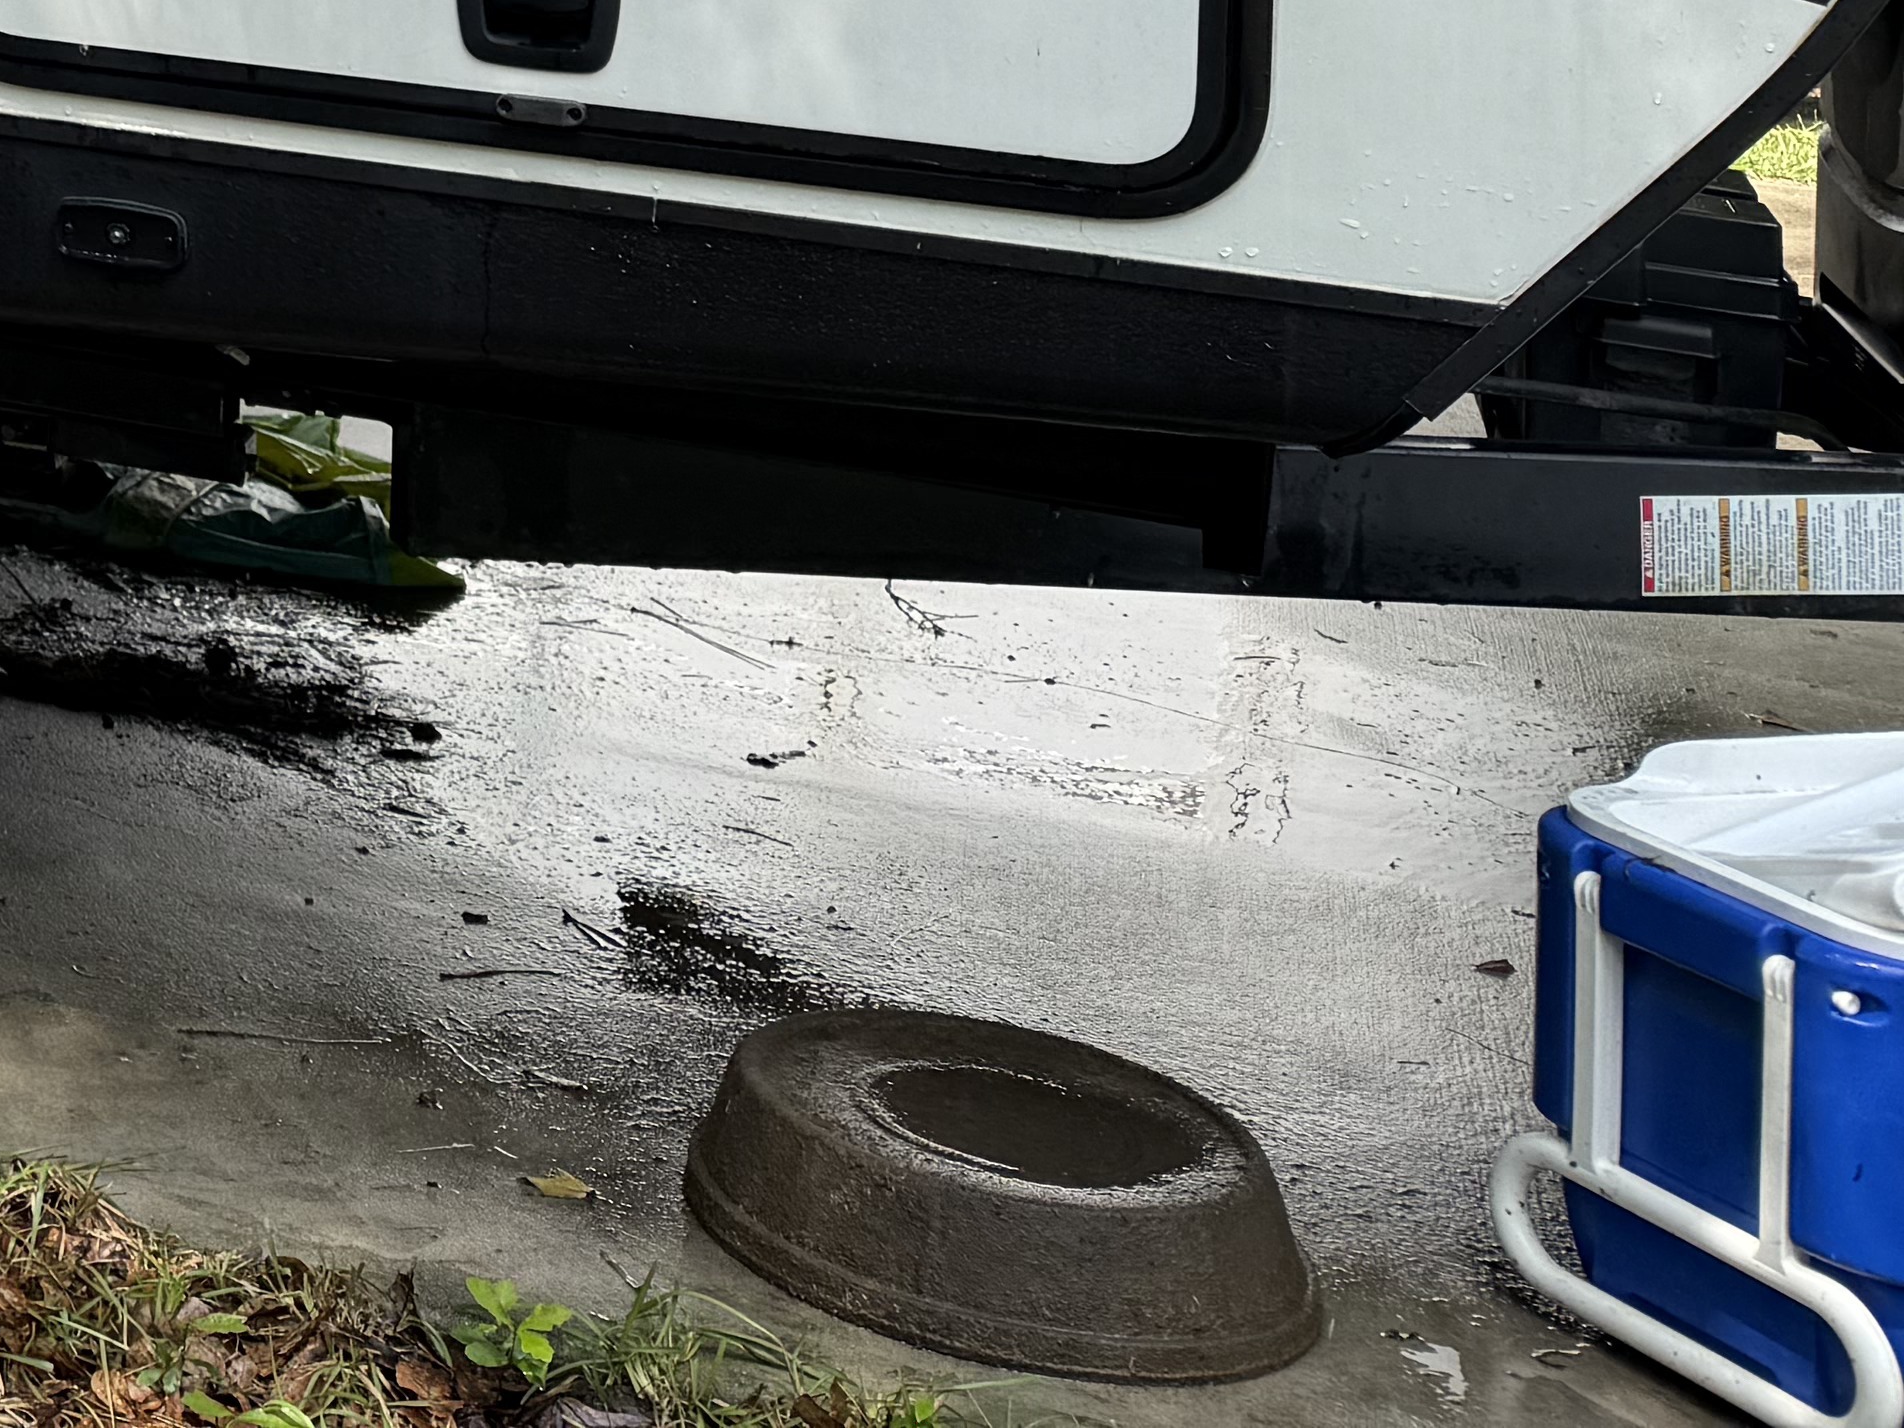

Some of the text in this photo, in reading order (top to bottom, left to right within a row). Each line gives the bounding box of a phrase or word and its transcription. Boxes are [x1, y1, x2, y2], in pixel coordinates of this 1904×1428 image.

[1643, 520, 1655, 568] DANGER
[1719, 515, 1732, 567] WARNING
[1797, 516, 1809, 566] WARNING
